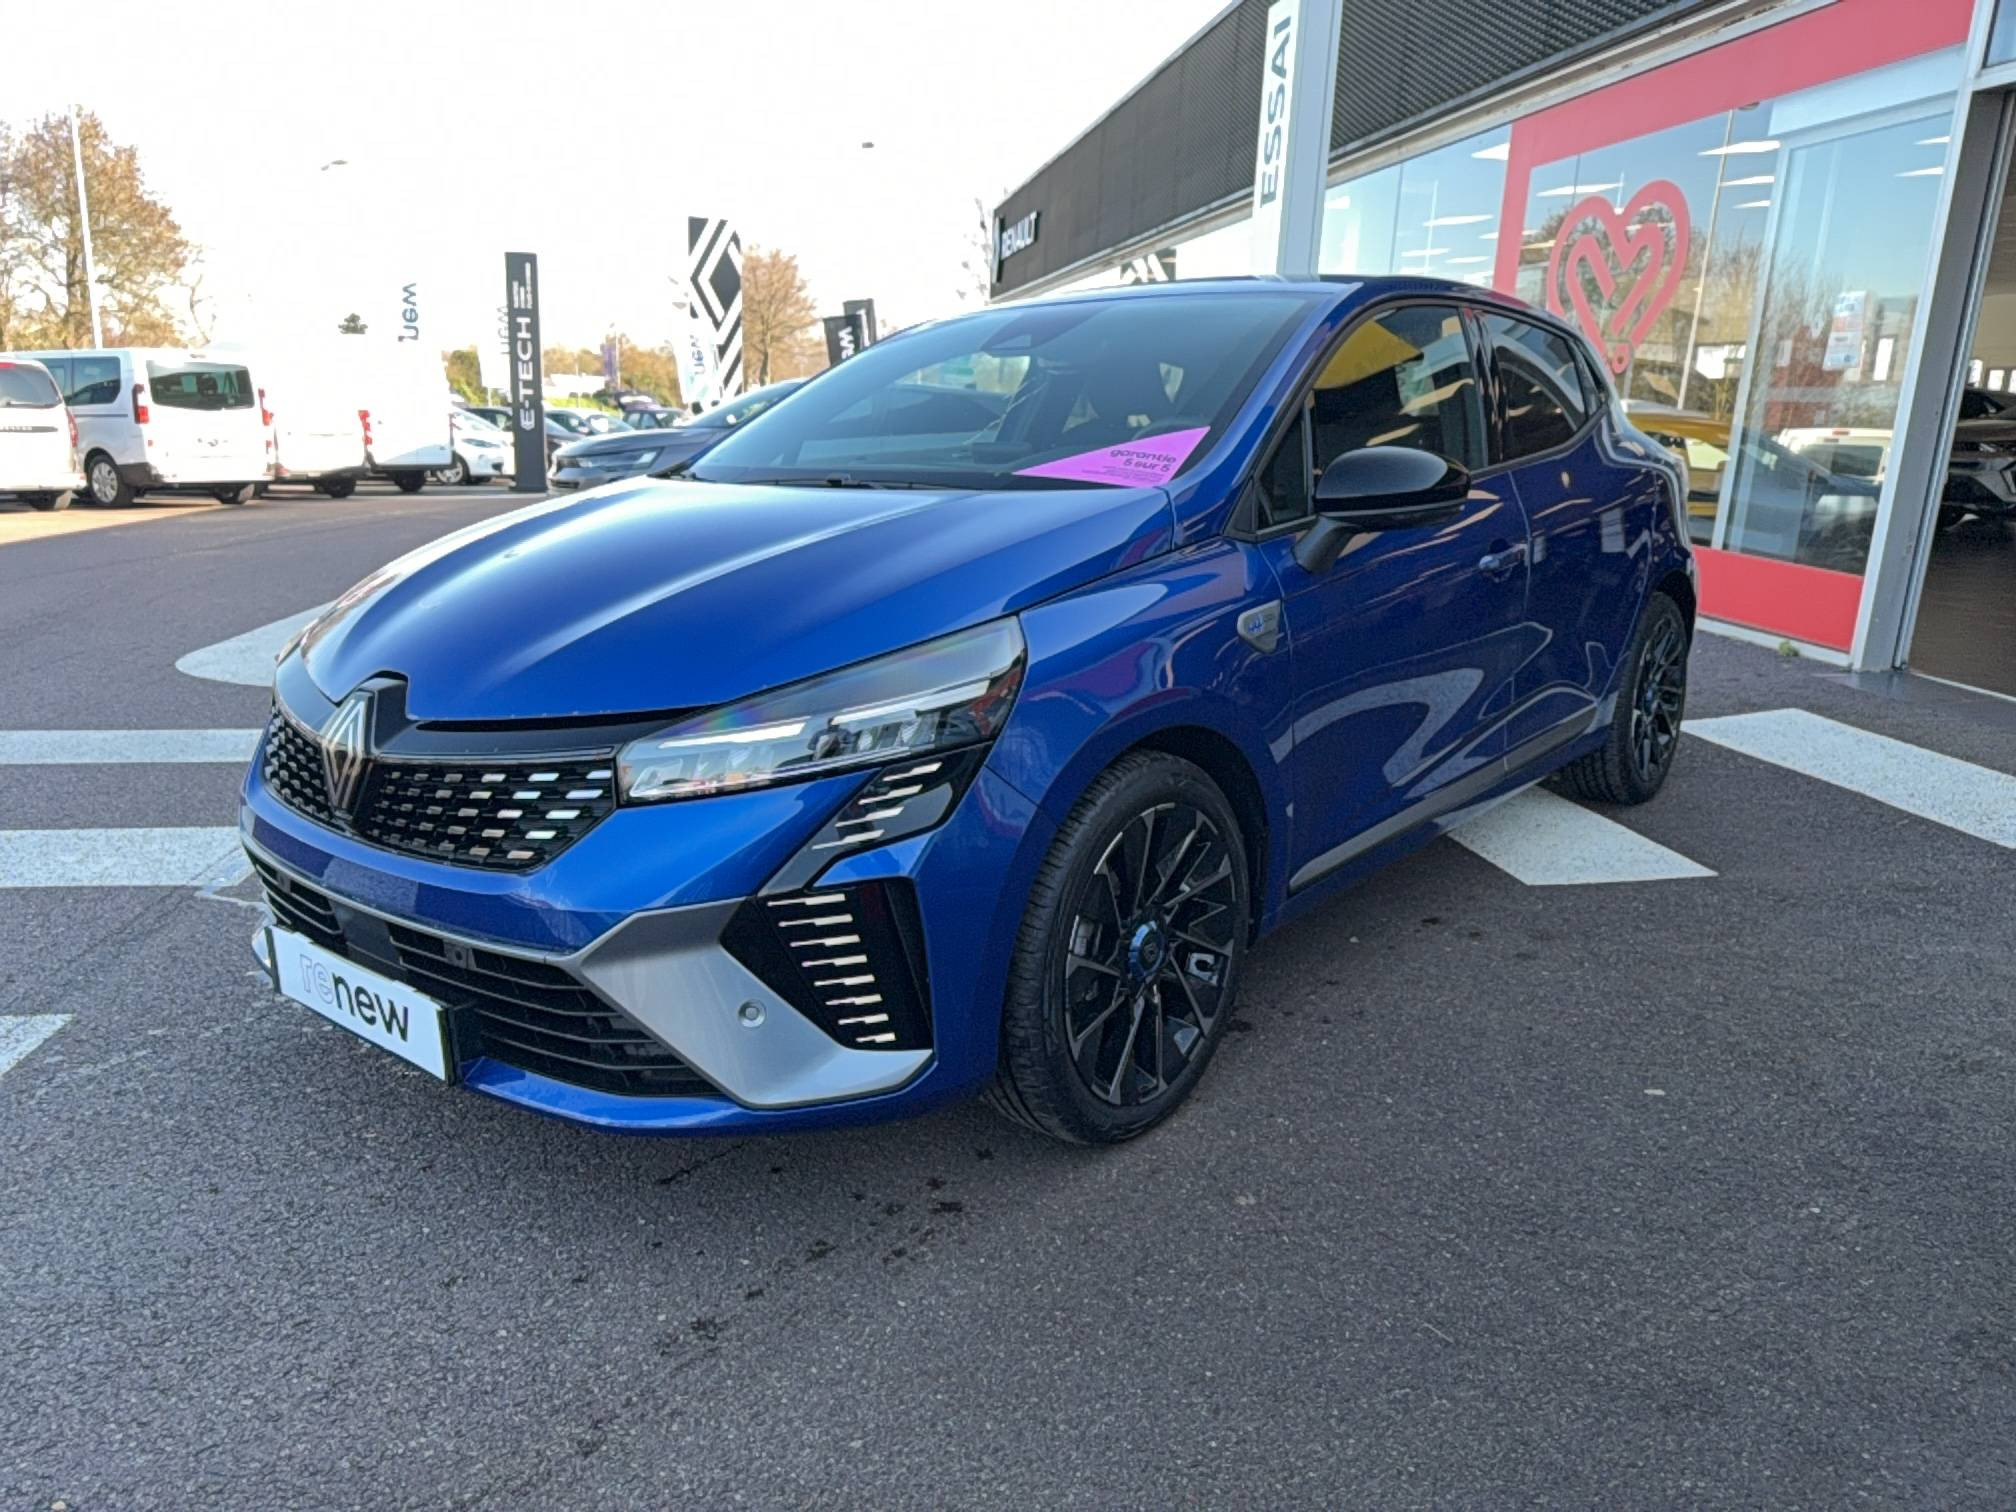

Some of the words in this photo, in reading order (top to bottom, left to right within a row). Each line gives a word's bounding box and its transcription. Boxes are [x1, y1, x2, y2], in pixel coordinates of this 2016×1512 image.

[1260, 16, 1292, 209] ESSAI
[516, 316, 536, 431] E-TECH
[1110, 449, 1176, 463] garantie
[1123, 458, 1132, 467] 5
[1134, 461, 1159, 471] sur
[1160, 463, 1171, 473] 5
[299, 953, 409, 1042] renew
